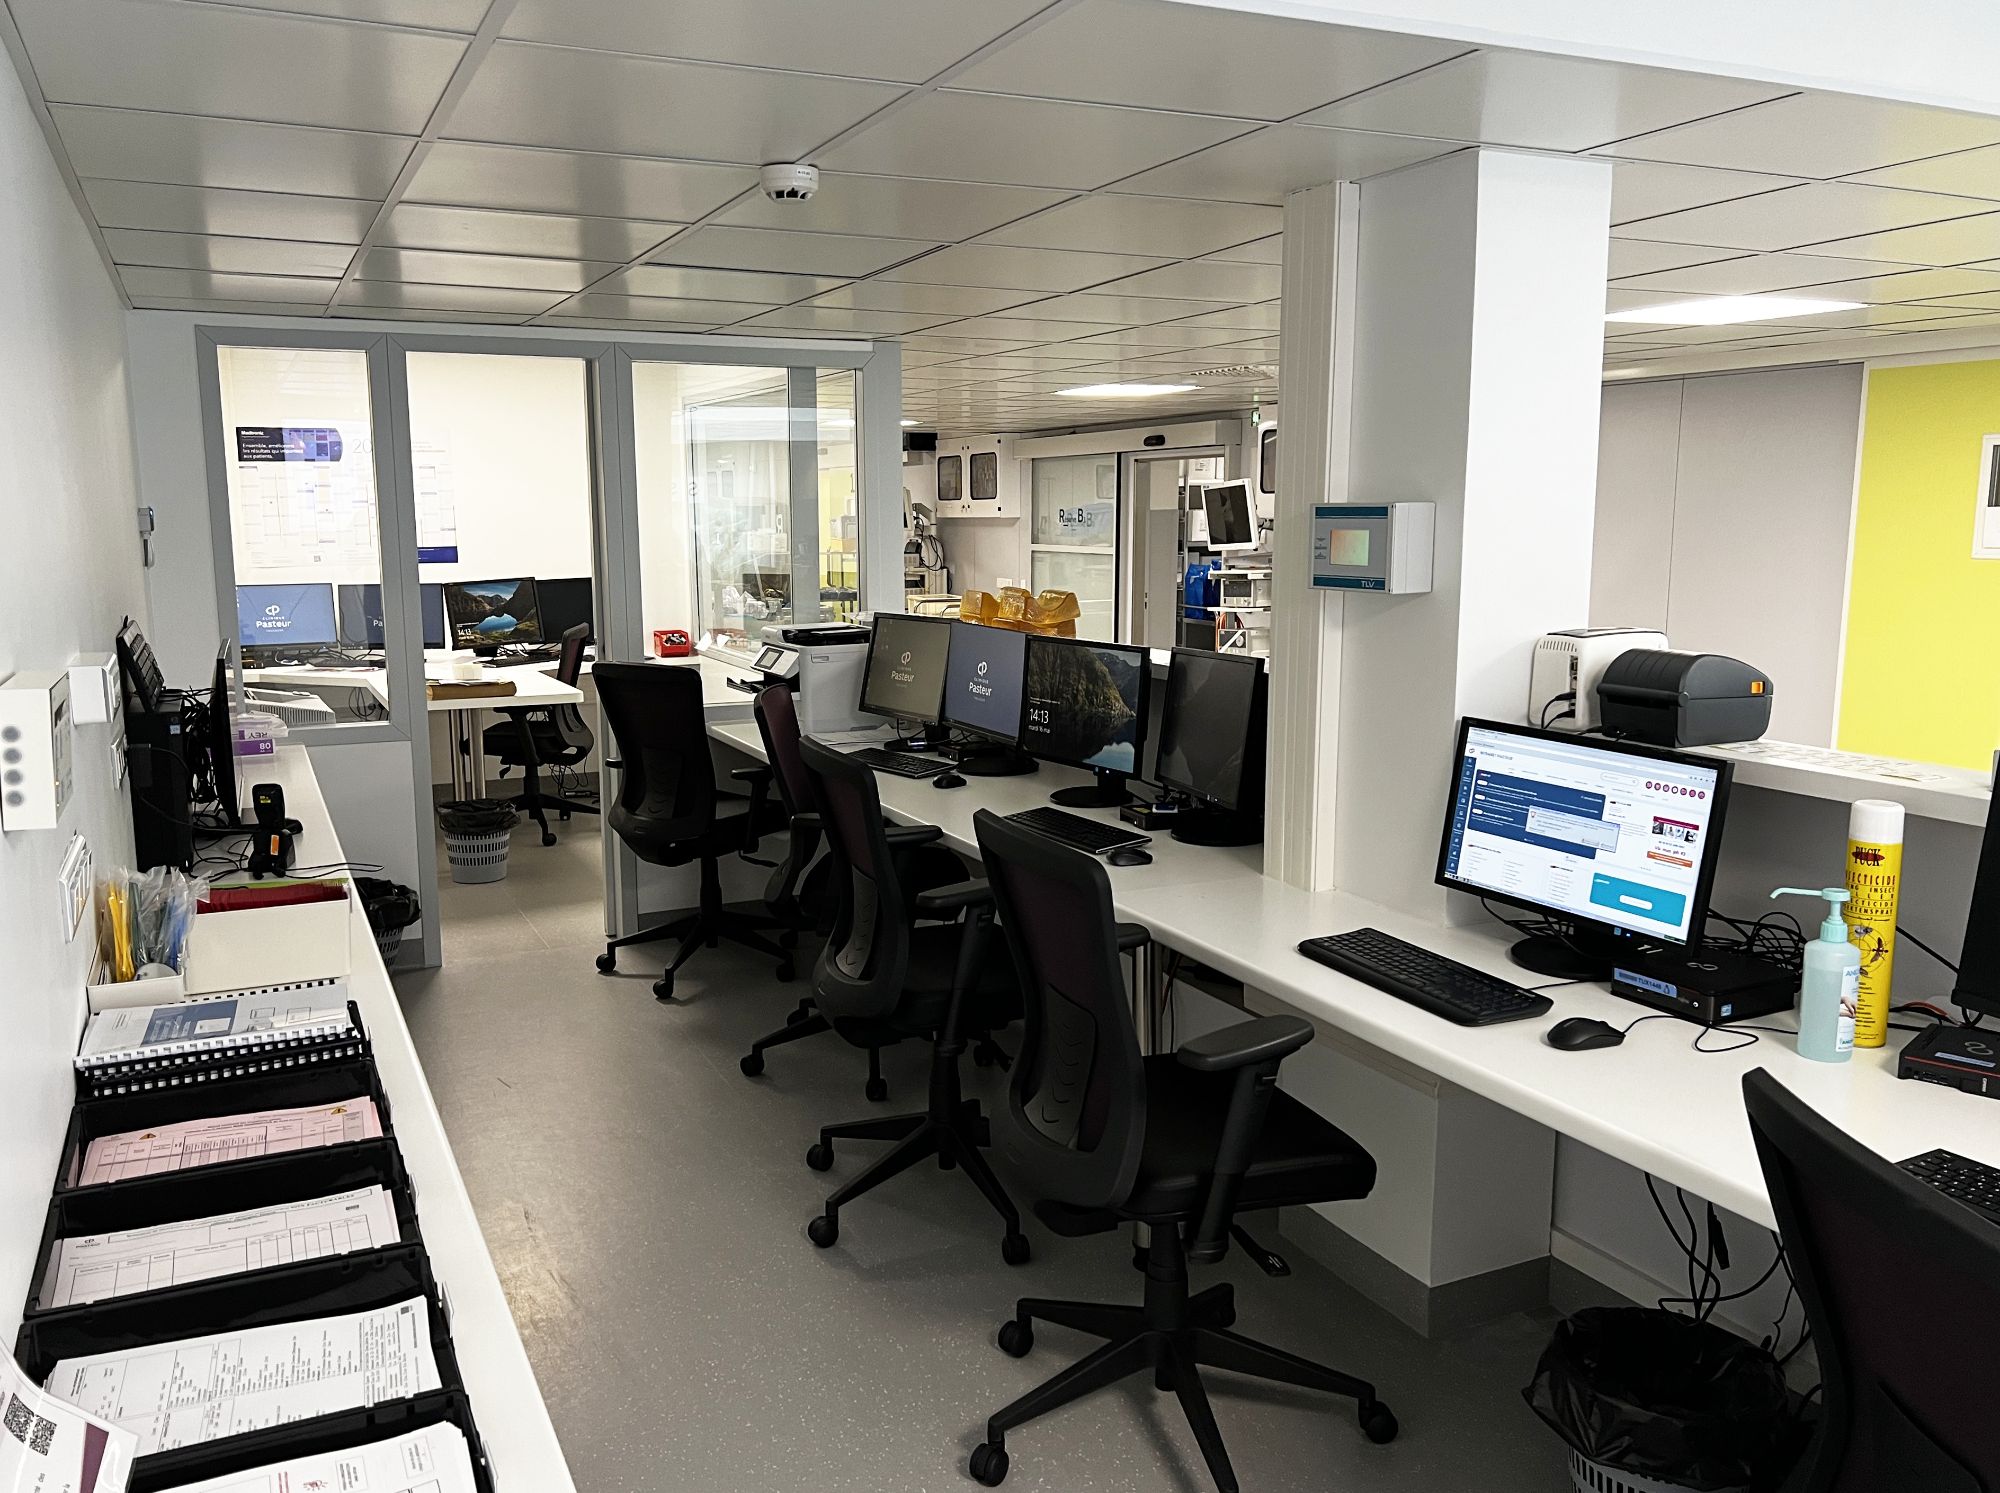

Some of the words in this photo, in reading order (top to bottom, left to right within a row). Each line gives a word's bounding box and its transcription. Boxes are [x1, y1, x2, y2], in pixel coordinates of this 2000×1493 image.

[1361, 580, 1375, 588] TLV
[255, 620, 292, 629] Pasteur
[891, 670, 915, 682] Pasteur
[969, 682, 992, 696] Pasteur
[1029, 708, 1049, 724] 14:13
